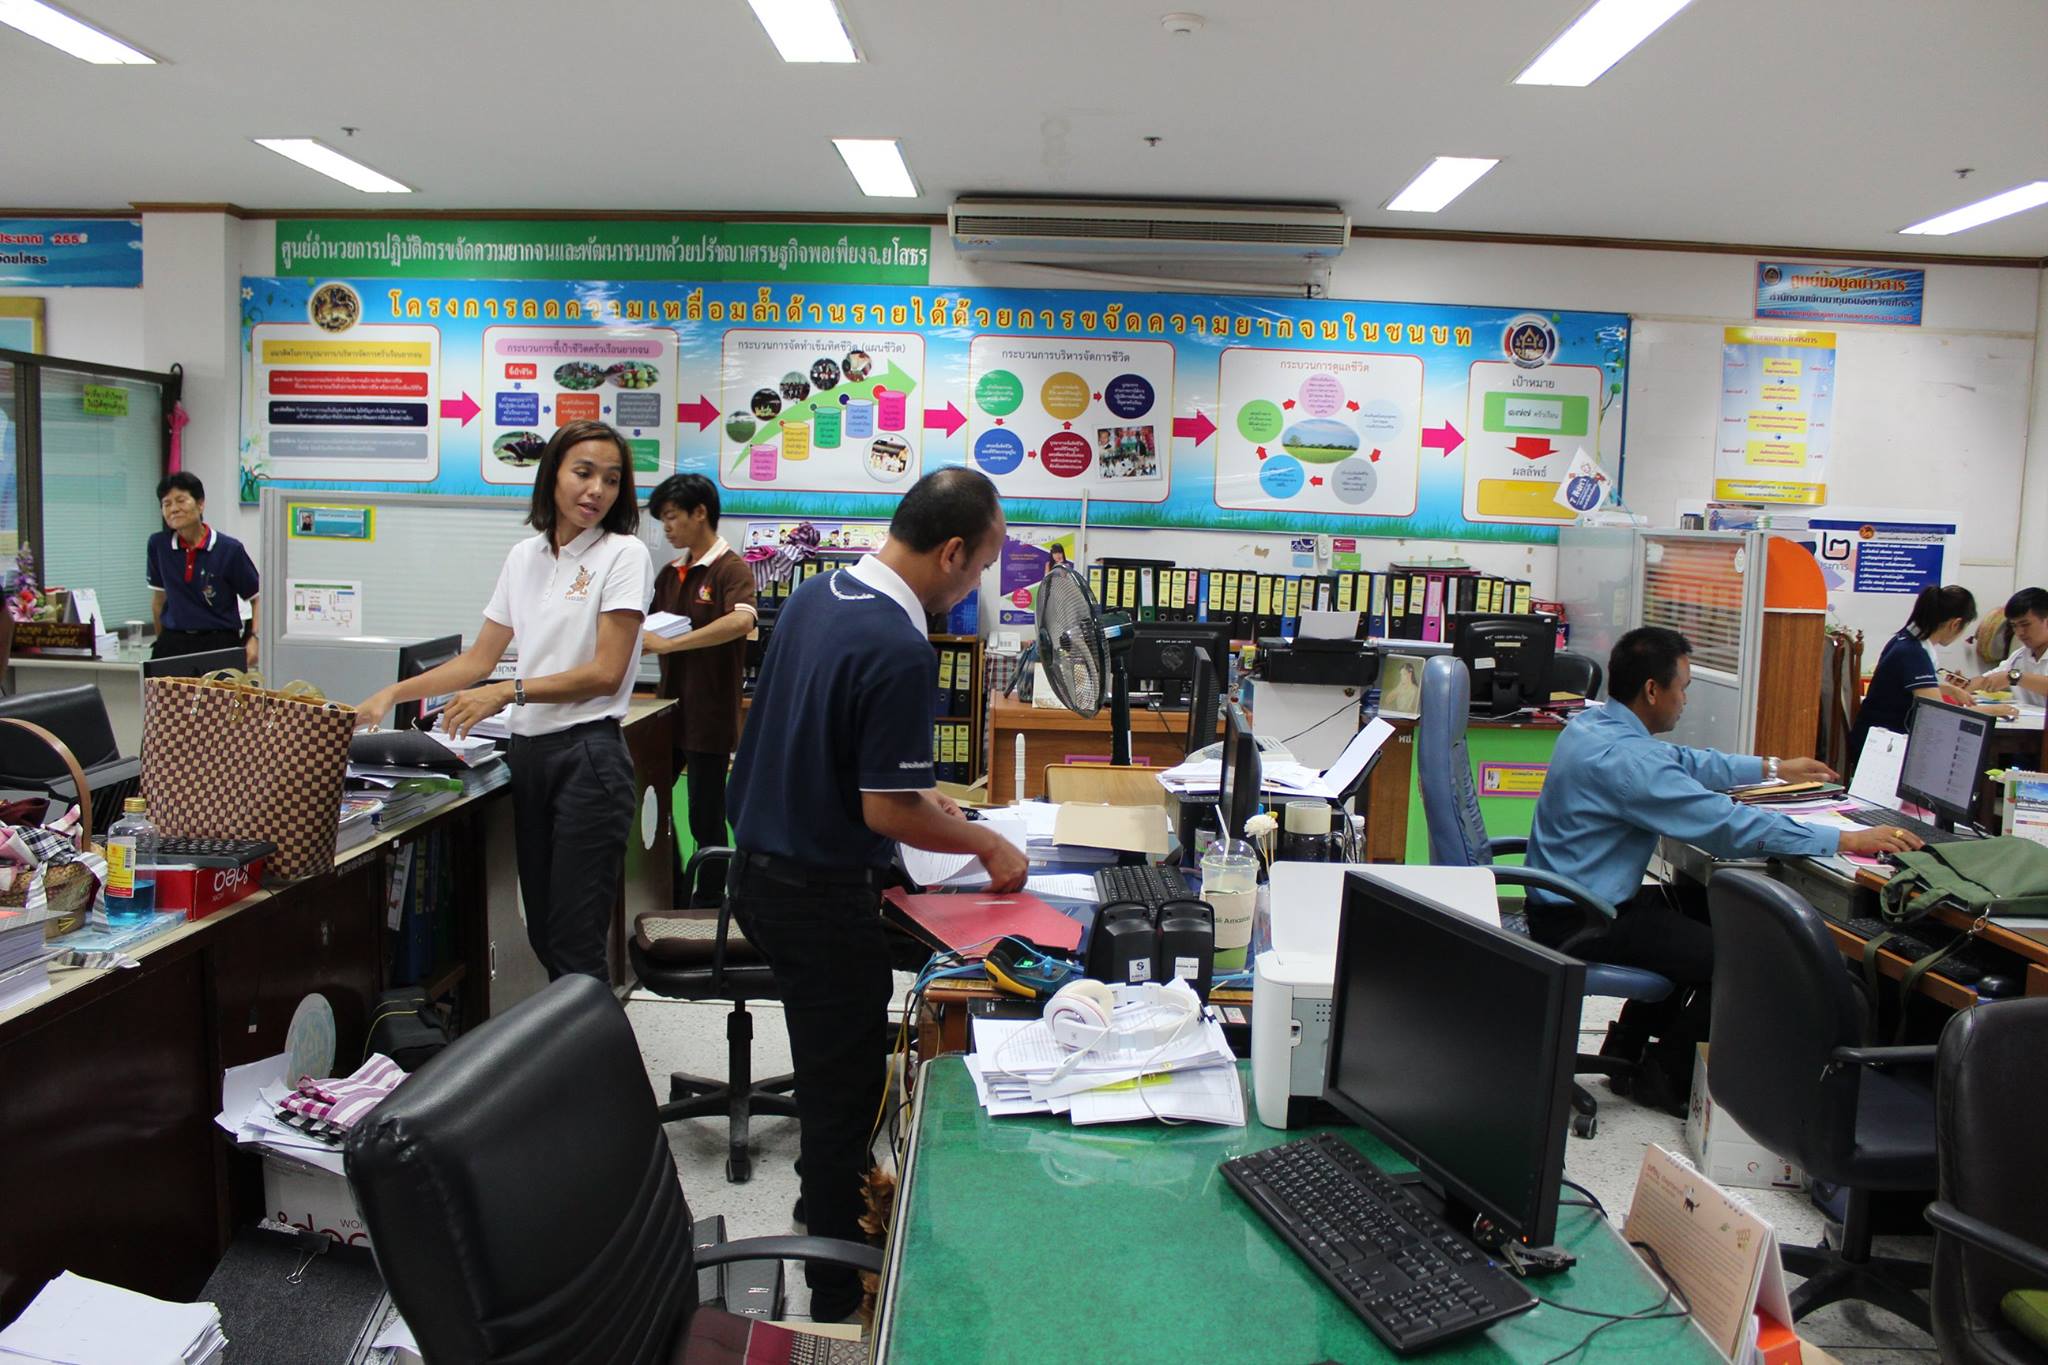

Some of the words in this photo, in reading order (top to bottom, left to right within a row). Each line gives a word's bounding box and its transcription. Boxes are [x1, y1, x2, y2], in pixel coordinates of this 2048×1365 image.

[861, 341, 906, 354] (แผนชีวิต)
[1001, 348, 1131, 363] กระบวนการบริหารจัดการชีวิต
[1512, 465, 1548, 478] ผลลัพธ์
